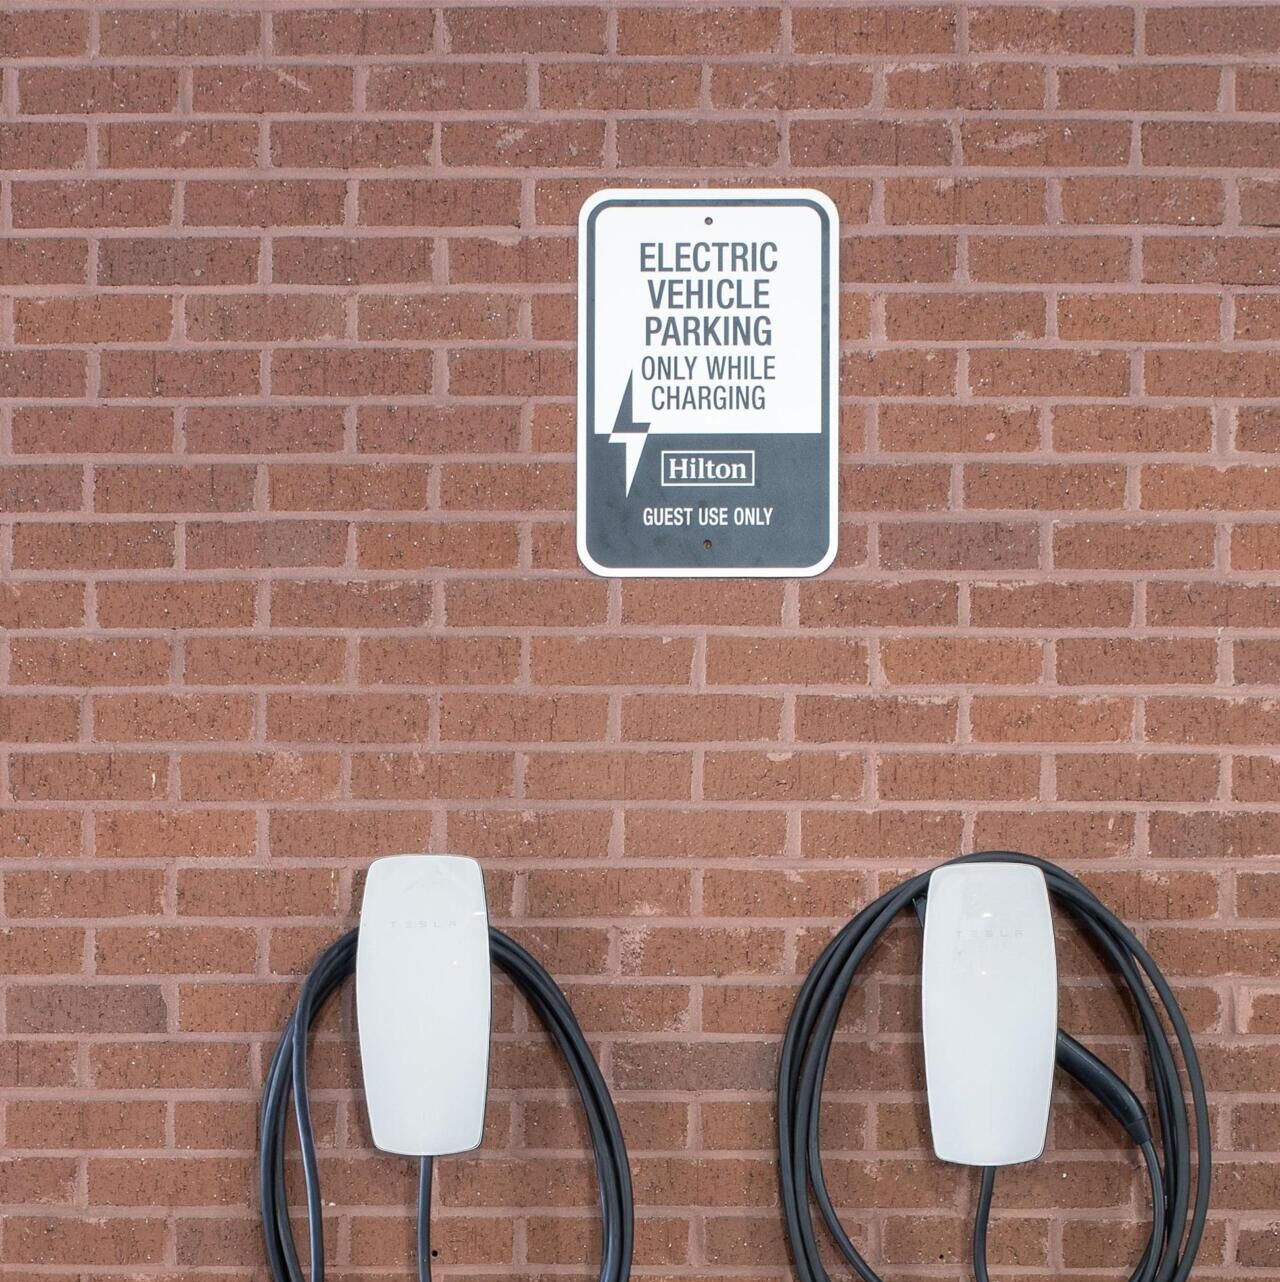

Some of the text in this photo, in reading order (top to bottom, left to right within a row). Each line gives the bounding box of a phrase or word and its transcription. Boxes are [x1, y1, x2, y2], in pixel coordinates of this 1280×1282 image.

[640, 242, 777, 272] ELECTRIC
[647, 279, 770, 309] VEHICLE
[646, 316, 771, 346] PARKING
[641, 355, 776, 380] ONLY WHILE
[651, 385, 766, 410] CHARGING
[669, 458, 746, 480] Hilton
[643, 508, 773, 526] GUEST USE ONLY
